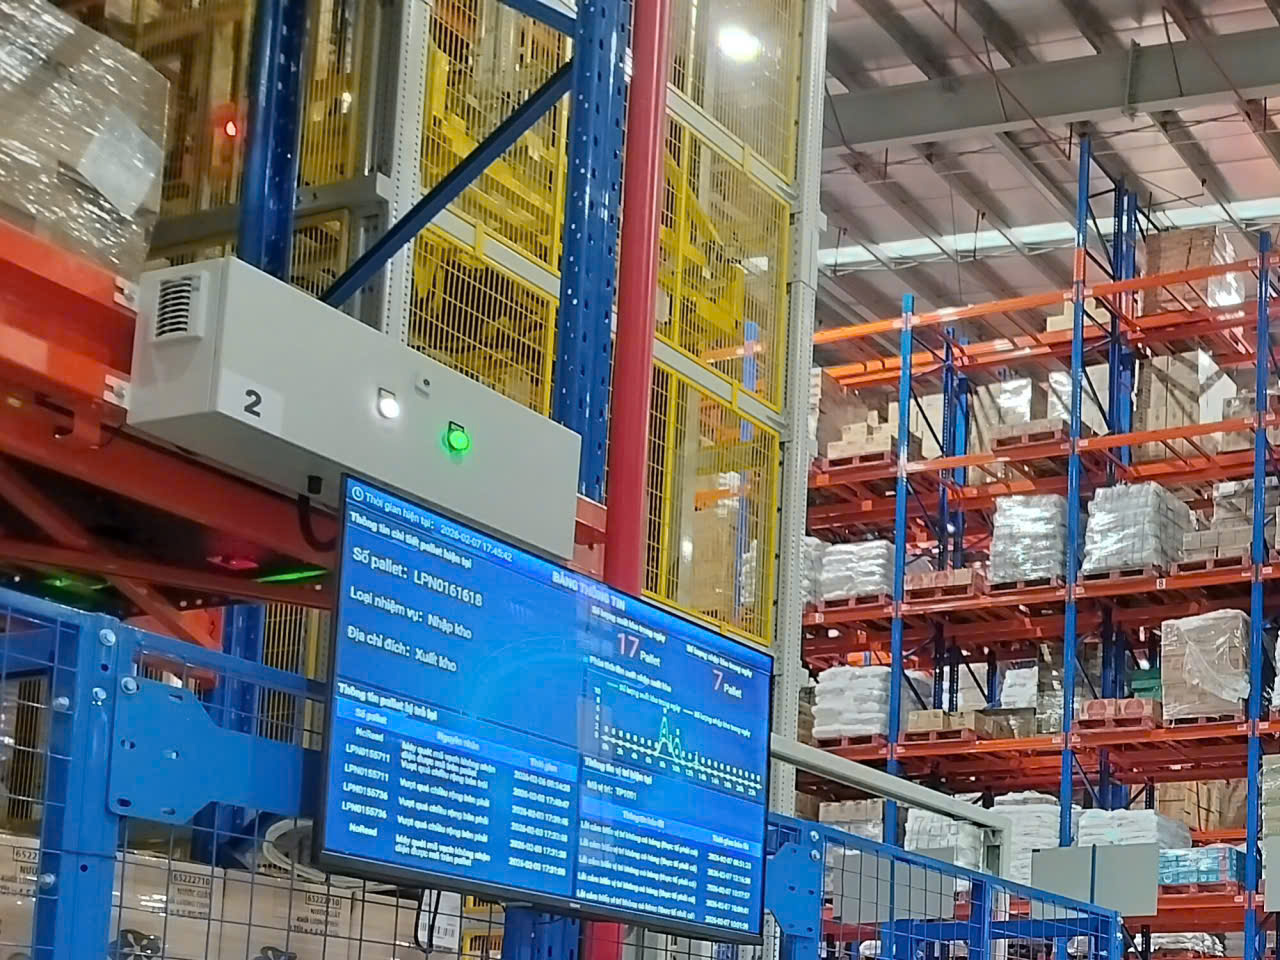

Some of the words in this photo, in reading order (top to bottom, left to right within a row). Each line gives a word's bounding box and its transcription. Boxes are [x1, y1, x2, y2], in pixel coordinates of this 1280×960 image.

[244, 389, 262, 418] 2
[384, 502, 402, 516] gian
[440, 524, 481, 548] 2026-02-07
[420, 540, 443, 557] pallet
[352, 547, 369, 564] Số
[371, 556, 408, 579] pallet:
[414, 570, 483, 608] LPN0161618
[350, 586, 373, 605] Loại
[374, 596, 406, 616] nhiệm
[427, 614, 453, 634] Nhập
[454, 623, 473, 640] kho
[617, 632, 640, 658] 17
[438, 656, 457, 672] kho
[338, 682, 367, 702] Thông
[380, 696, 404, 712] pallet
[712, 670, 723, 690] 7
[724, 683, 743, 699] Pallet
